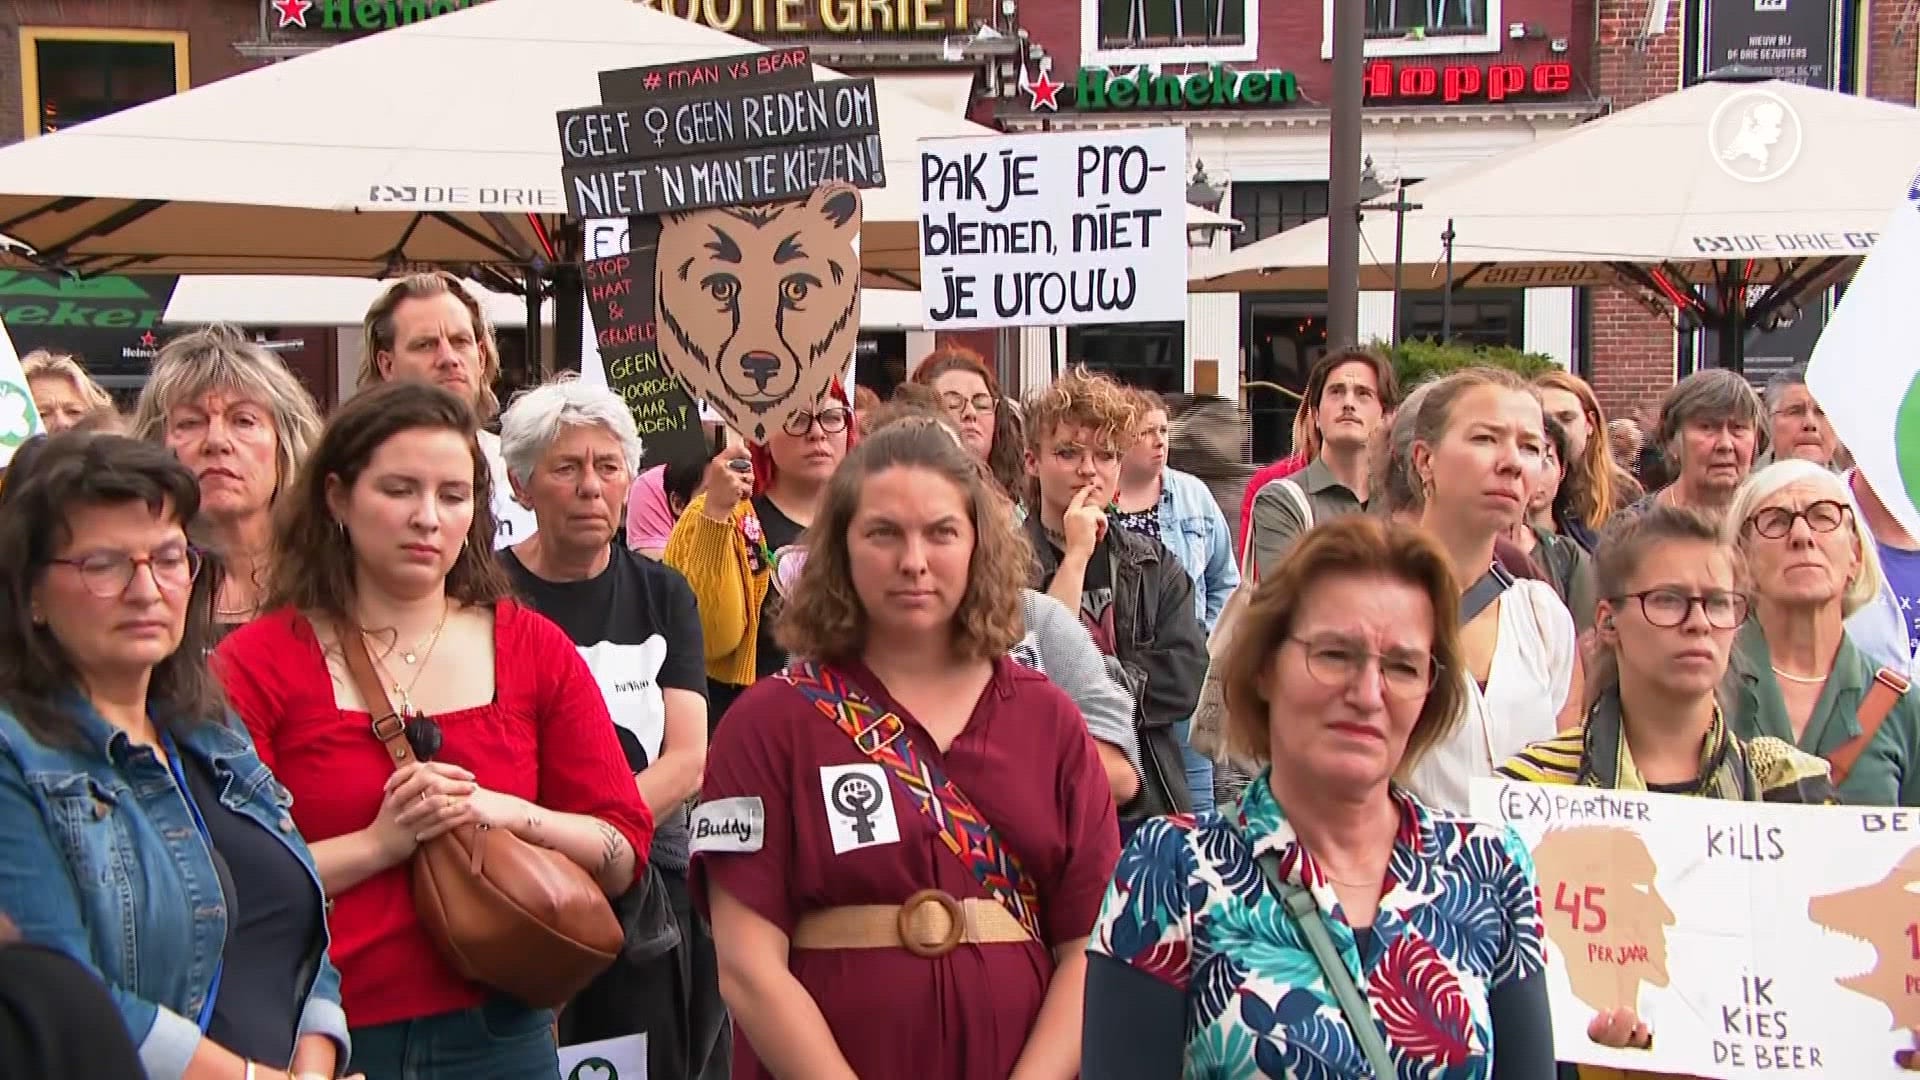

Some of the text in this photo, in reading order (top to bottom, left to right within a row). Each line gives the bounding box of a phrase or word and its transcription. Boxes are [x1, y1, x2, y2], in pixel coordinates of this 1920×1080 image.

[1749, 35, 1777, 46] NIEUW
[756, 50, 806, 75] BEAR
[1075, 66, 1297, 109] Heineken
[564, 85, 873, 158] GEEF GEEN REDEN OM
[424, 186, 557, 206] DE DRIE
[574, 169, 646, 216] NIET
[655, 162, 686, 208] 'N
[691, 160, 743, 203] MAN
[744, 154, 776, 197] TE
[1733, 234, 1771, 251] DE
[1776, 232, 1842, 251] DRIE
[586, 256, 631, 280] STOP
[591, 278, 633, 302] HAAT
[608, 301, 625, 321] &
[599, 322, 656, 347] GEWELD
[610, 351, 657, 379] GEEN
[696, 817, 751, 843] Buddy
[1555, 881, 1607, 933] 45
[1588, 942, 1614, 963] PER
[1617, 944, 1648, 965] JAAR
[1713, 1040, 1823, 1069] DE BEER
